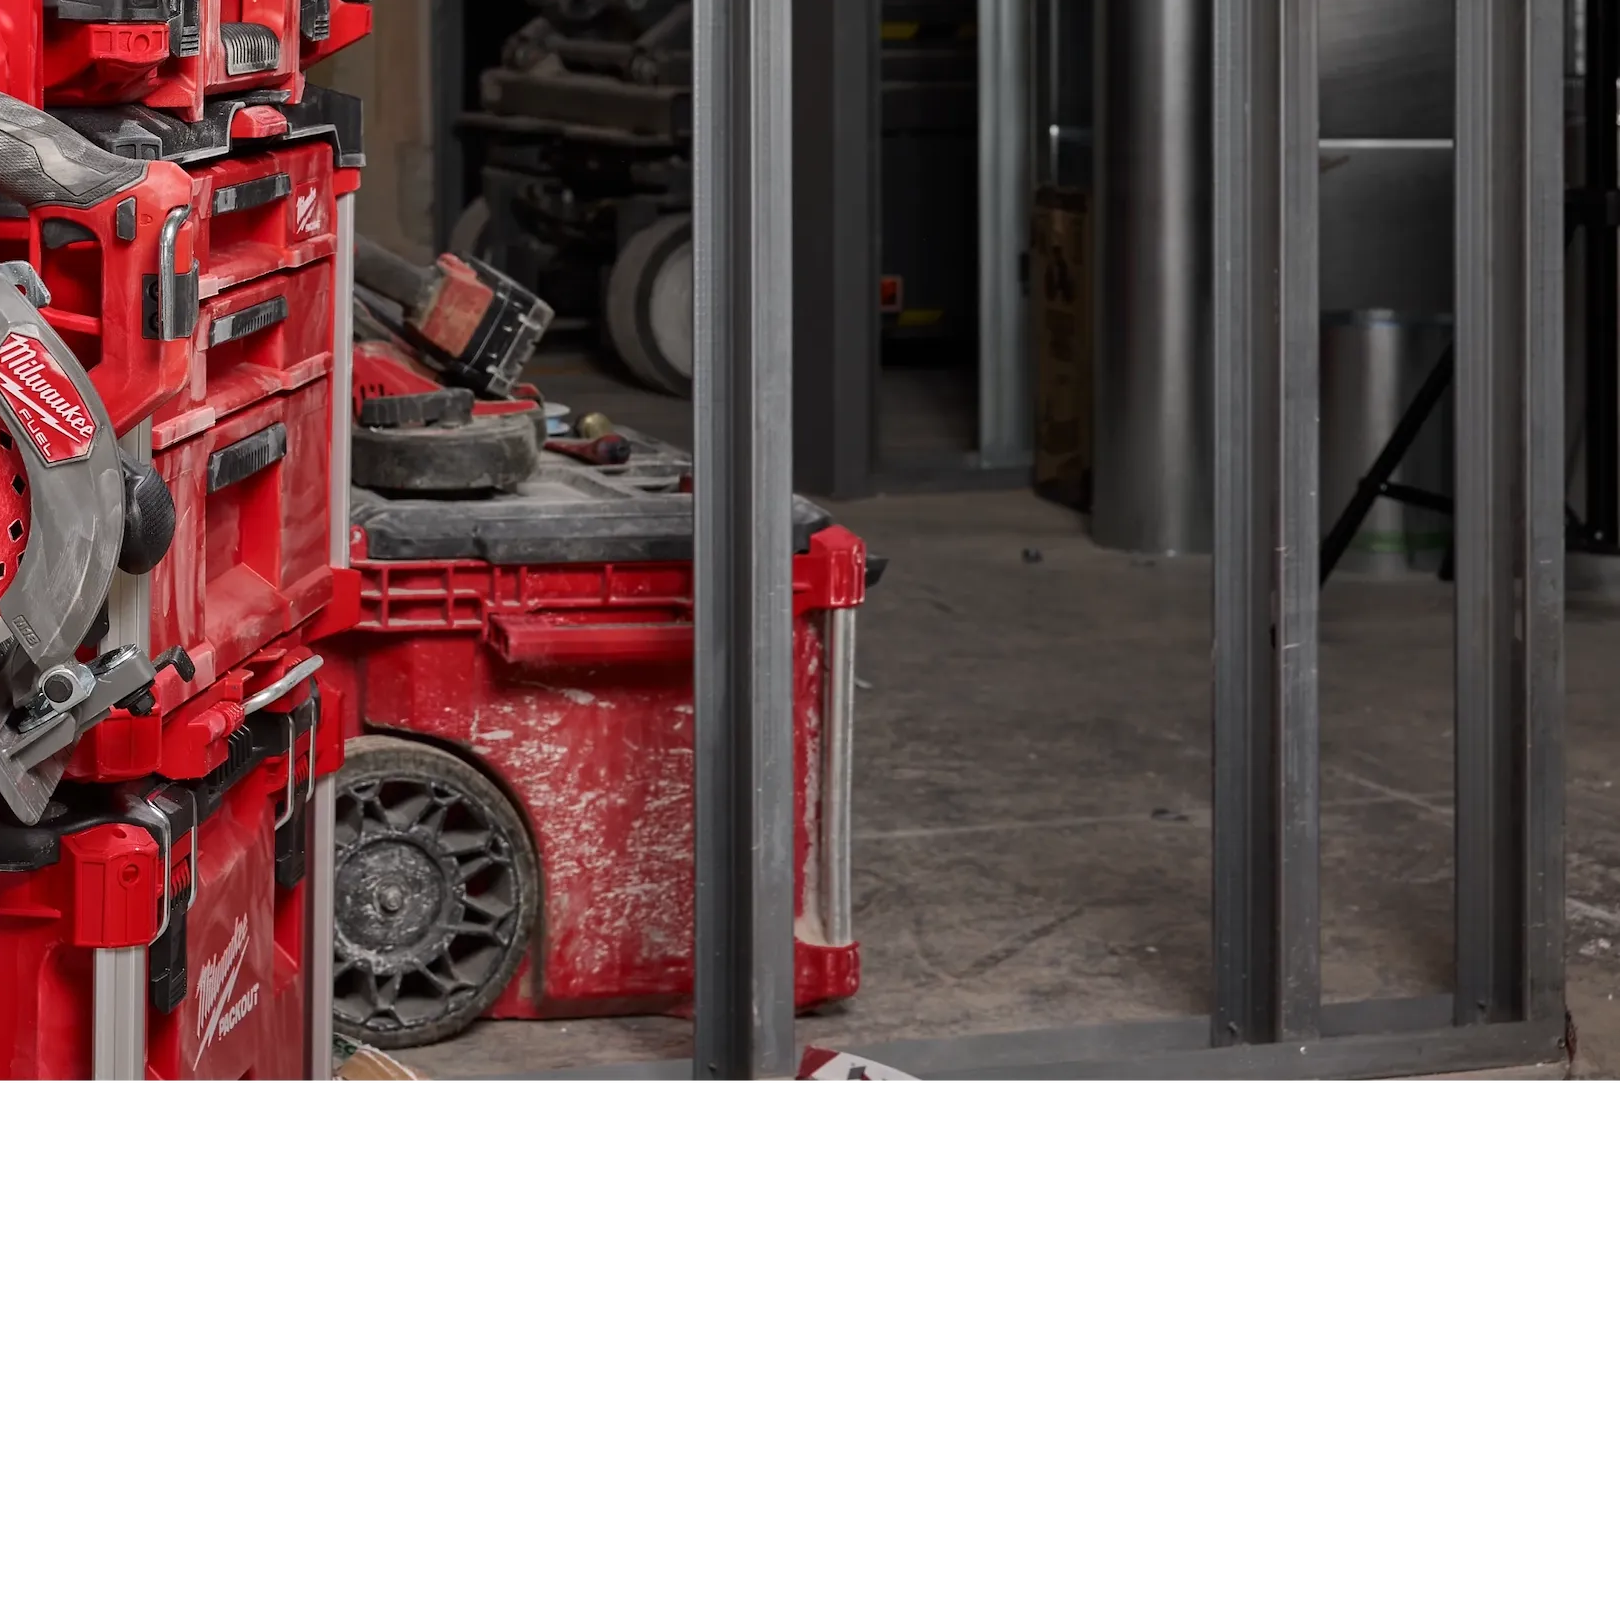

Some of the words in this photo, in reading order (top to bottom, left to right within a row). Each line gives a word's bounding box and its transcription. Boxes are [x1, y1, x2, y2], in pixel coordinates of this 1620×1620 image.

[18, 407, 51, 457] FUEL
[195, 911, 249, 1040] Milwaukee
[218, 982, 260, 1041] PACKOUT
